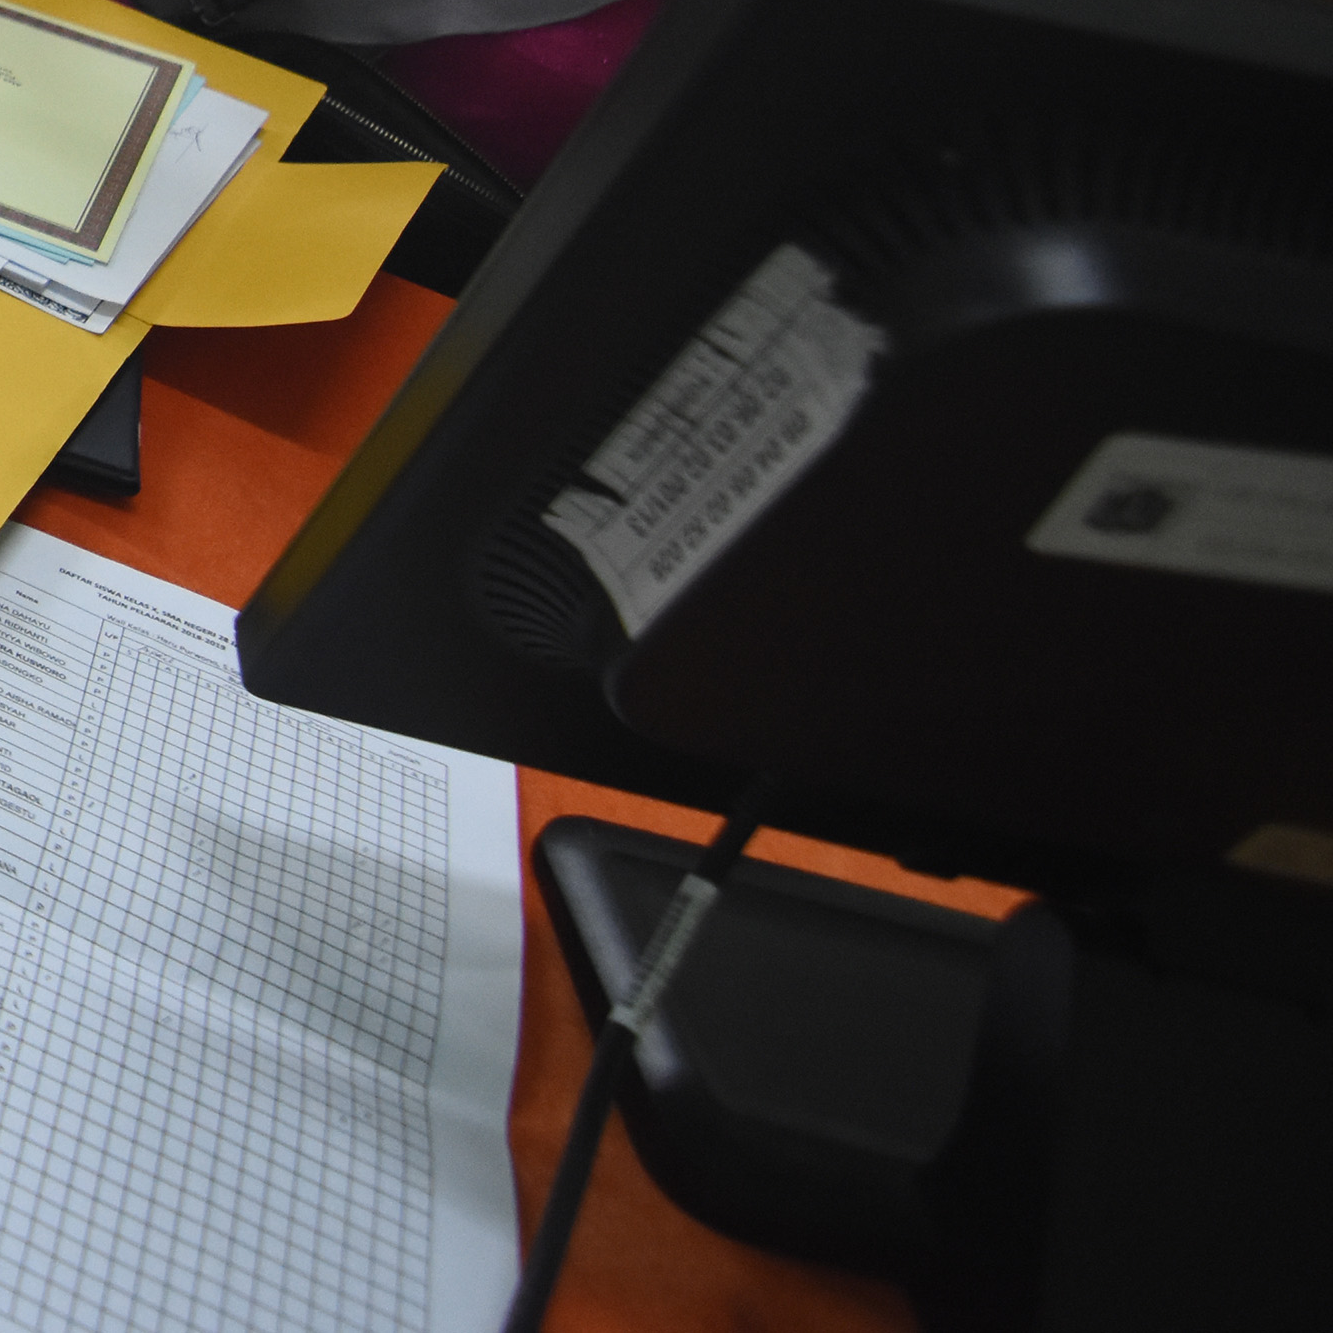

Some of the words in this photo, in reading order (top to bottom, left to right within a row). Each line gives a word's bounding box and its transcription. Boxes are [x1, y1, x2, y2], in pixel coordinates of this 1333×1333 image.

[15, 590, 39, 604] Nama
[59, 567, 92, 586] DAFTAR
[94, 581, 122, 598] SISWA
[123, 593, 150, 609] KELAS
[162, 609, 182, 623] SMA
[183, 619, 216, 637] NEGERI
[11, 609, 51, 631] DAHAYU
[97, 592, 128, 609] TAHUN
[130, 606, 179, 631] PELAJARAN
[5, 619, 48, 644] RIDHANTI
[16, 652, 67, 680] KUSWORO
[24, 641, 66, 666] WIBOWO
